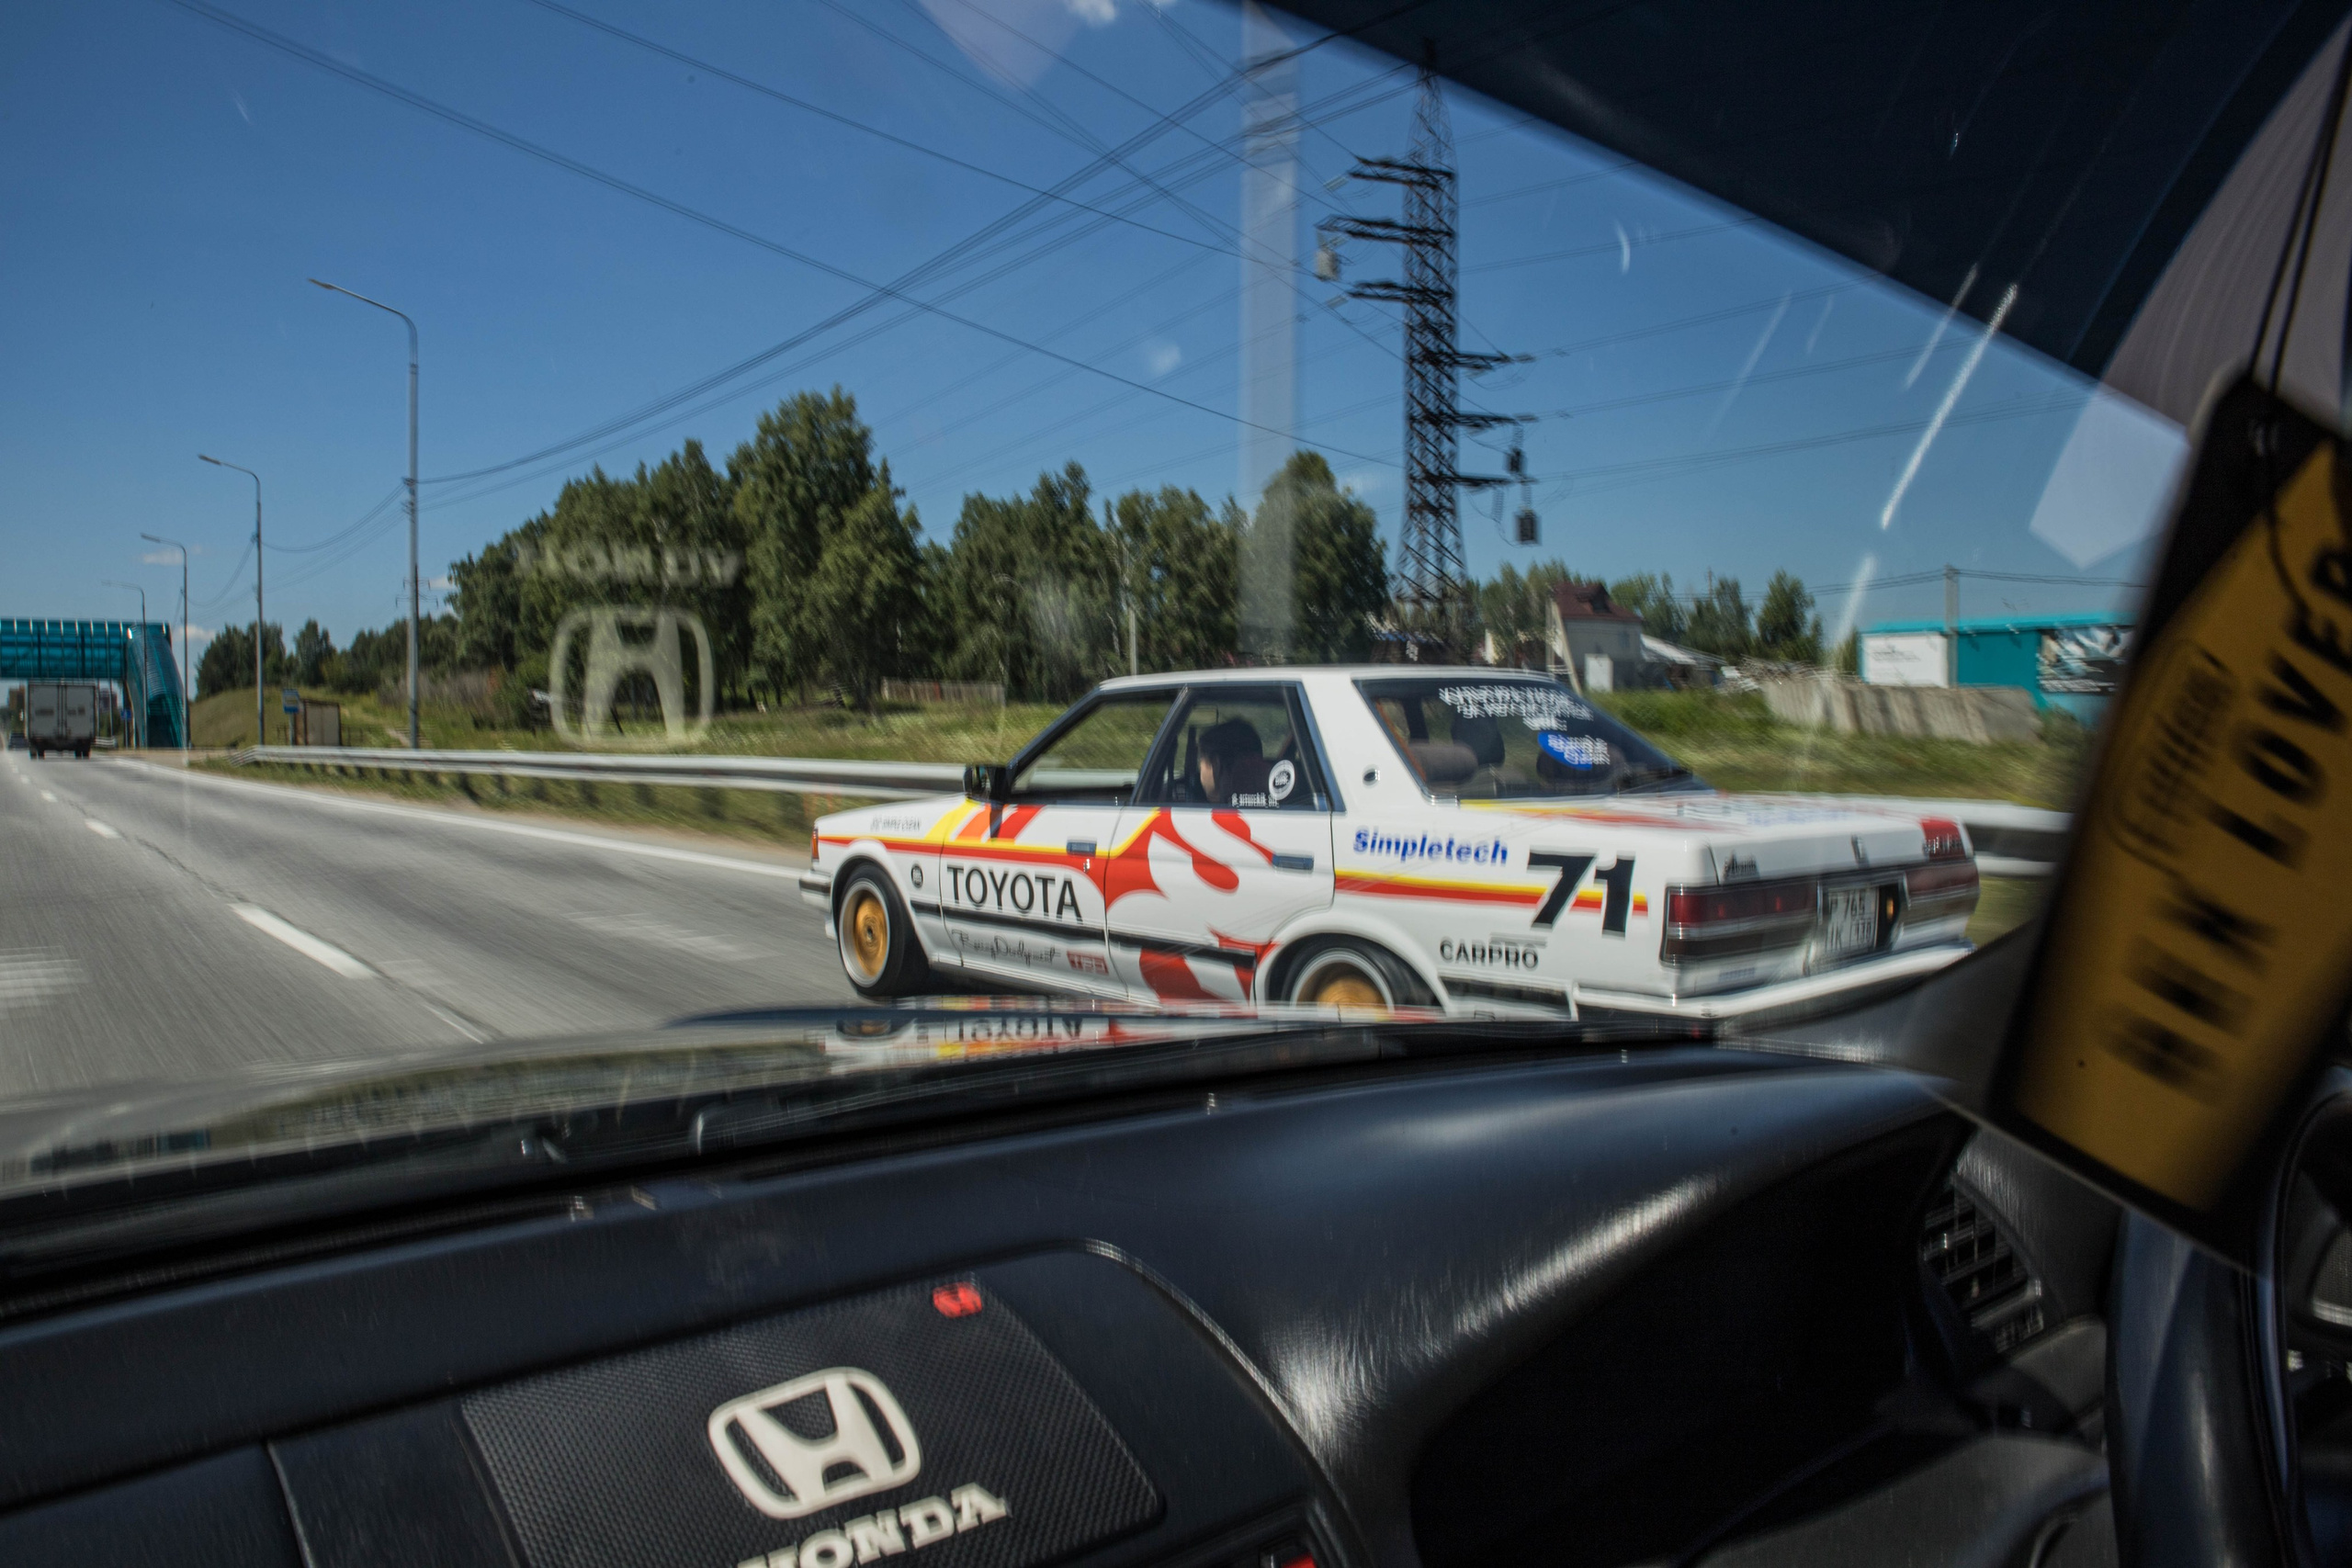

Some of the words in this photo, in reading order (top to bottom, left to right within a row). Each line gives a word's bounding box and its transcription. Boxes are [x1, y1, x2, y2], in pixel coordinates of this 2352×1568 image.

[1353, 827, 1508, 866] Simpletech
[947, 863, 1083, 924] TOYOTA
[1527, 847, 1635, 938] 71
[1440, 937, 1539, 970] CARPRO
